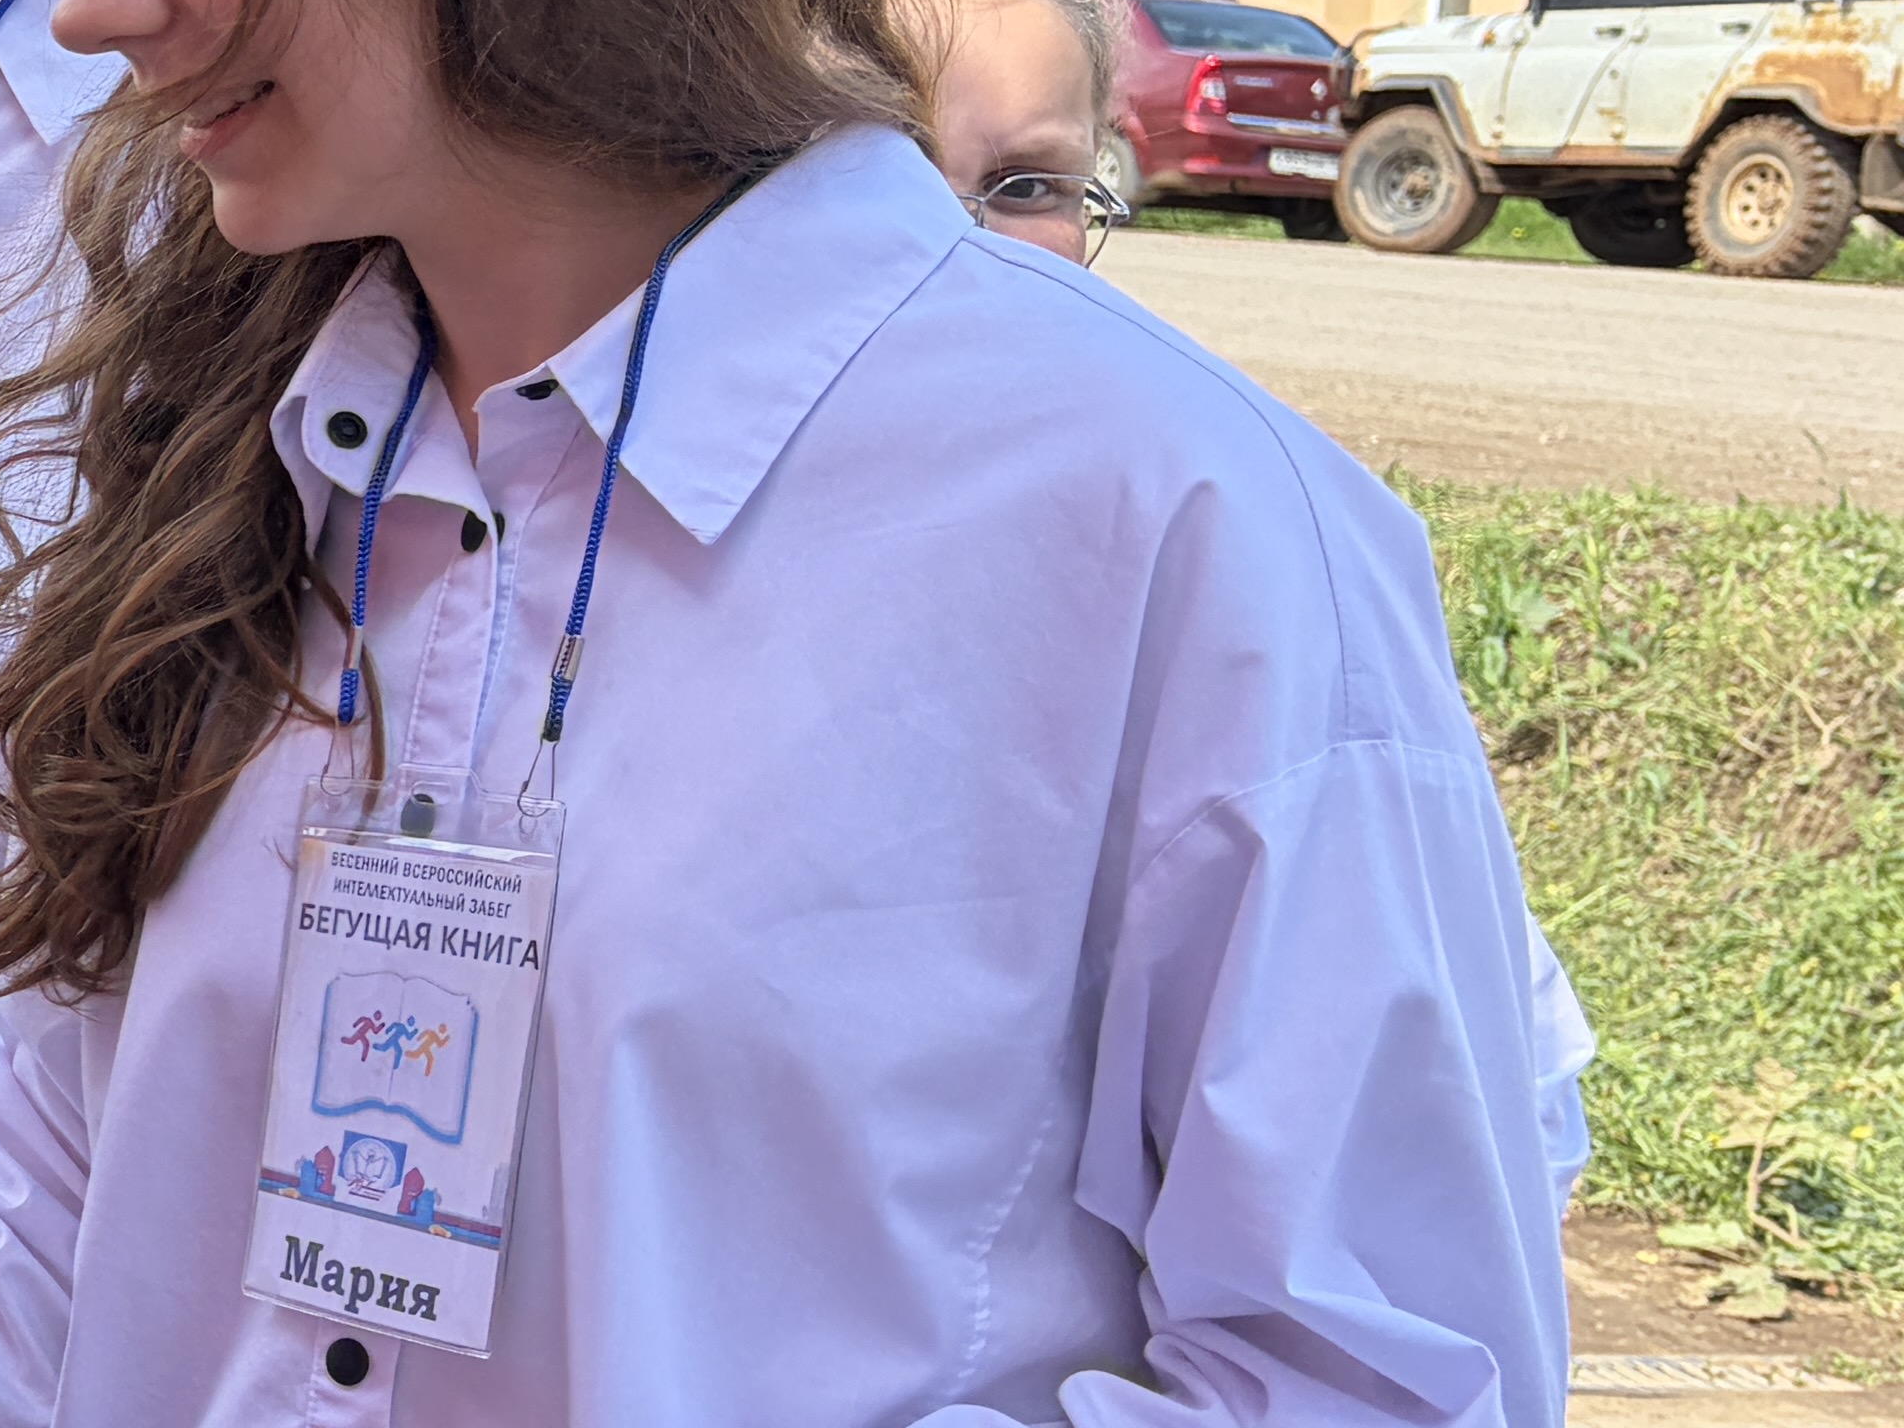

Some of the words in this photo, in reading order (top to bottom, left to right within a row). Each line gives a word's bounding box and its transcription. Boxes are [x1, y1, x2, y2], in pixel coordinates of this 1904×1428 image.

[331, 851, 399, 876] ВЕСЕННИЙ
[402, 862, 522, 894] ВСЕРОССИЙСКИЙ
[333, 877, 466, 912] ИНТЕЛЛЕКТУАЛЬНЫЙ
[468, 898, 513, 919] ЗАБЕГ
[298, 903, 433, 952] БЕГУЩАЯ
[440, 925, 540, 971] КНИГА
[279, 1234, 441, 1322] Мария
